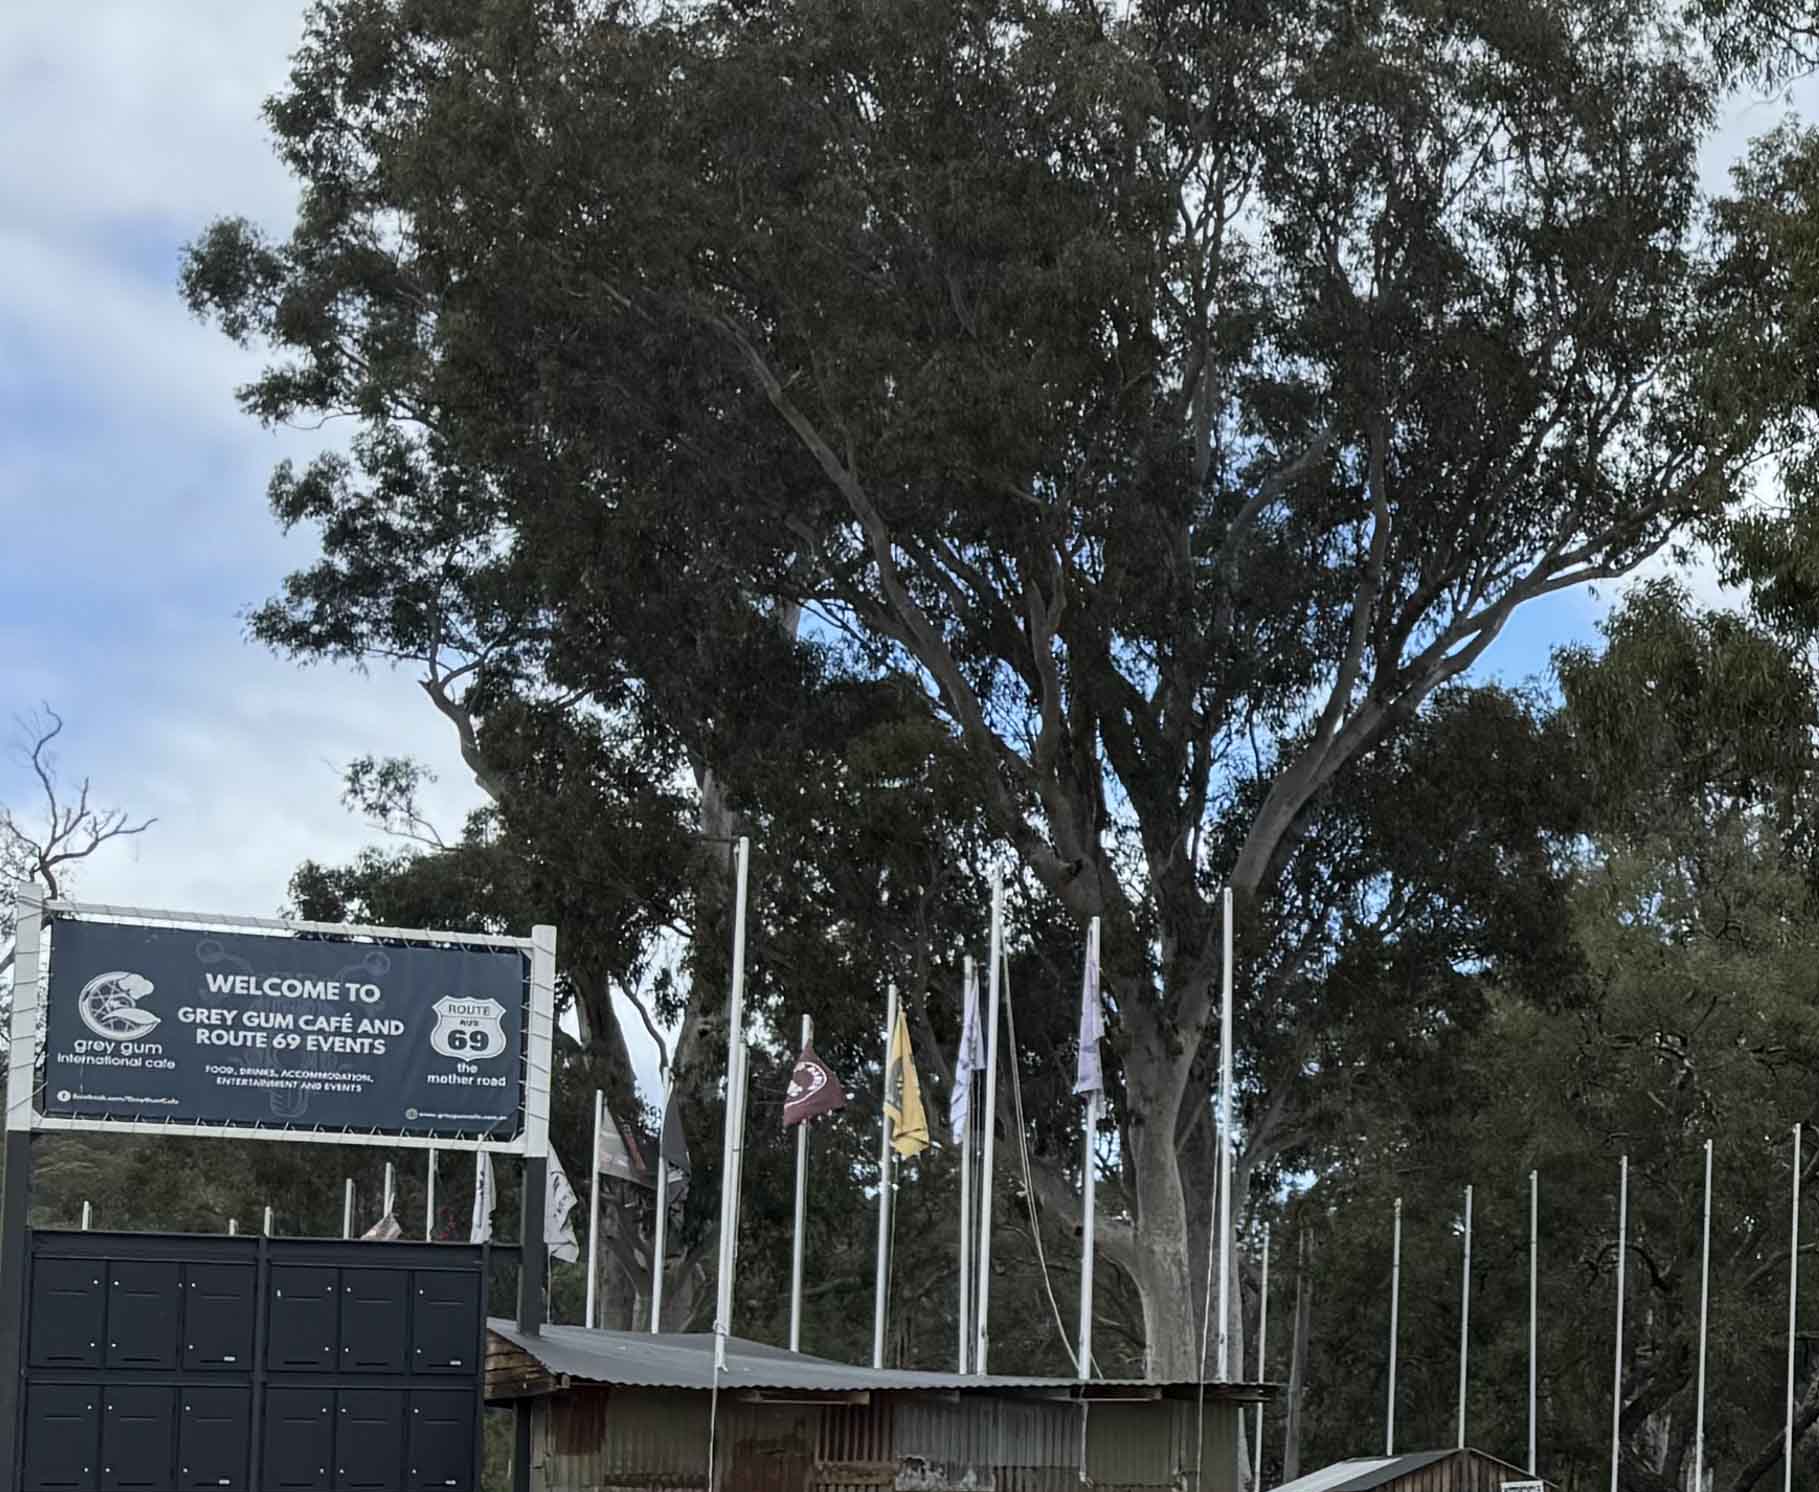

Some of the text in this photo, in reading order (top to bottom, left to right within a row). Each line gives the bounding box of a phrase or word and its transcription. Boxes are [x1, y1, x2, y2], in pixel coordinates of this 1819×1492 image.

[205, 973, 380, 1003] WELCOME TO
[448, 1004, 490, 1015] ROUTE
[177, 1006, 404, 1036] GREY GUM CAFÉ AND
[74, 1039, 163, 1056] grey gum
[196, 1028, 386, 1055] ROUTE 69 EVENTS
[447, 1029, 489, 1052] 69
[457, 1062, 478, 1074] the
[300, 1081, 322, 1091] AND
[324, 1082, 362, 1093] EVENTS
[427, 1073, 507, 1087] mother road
